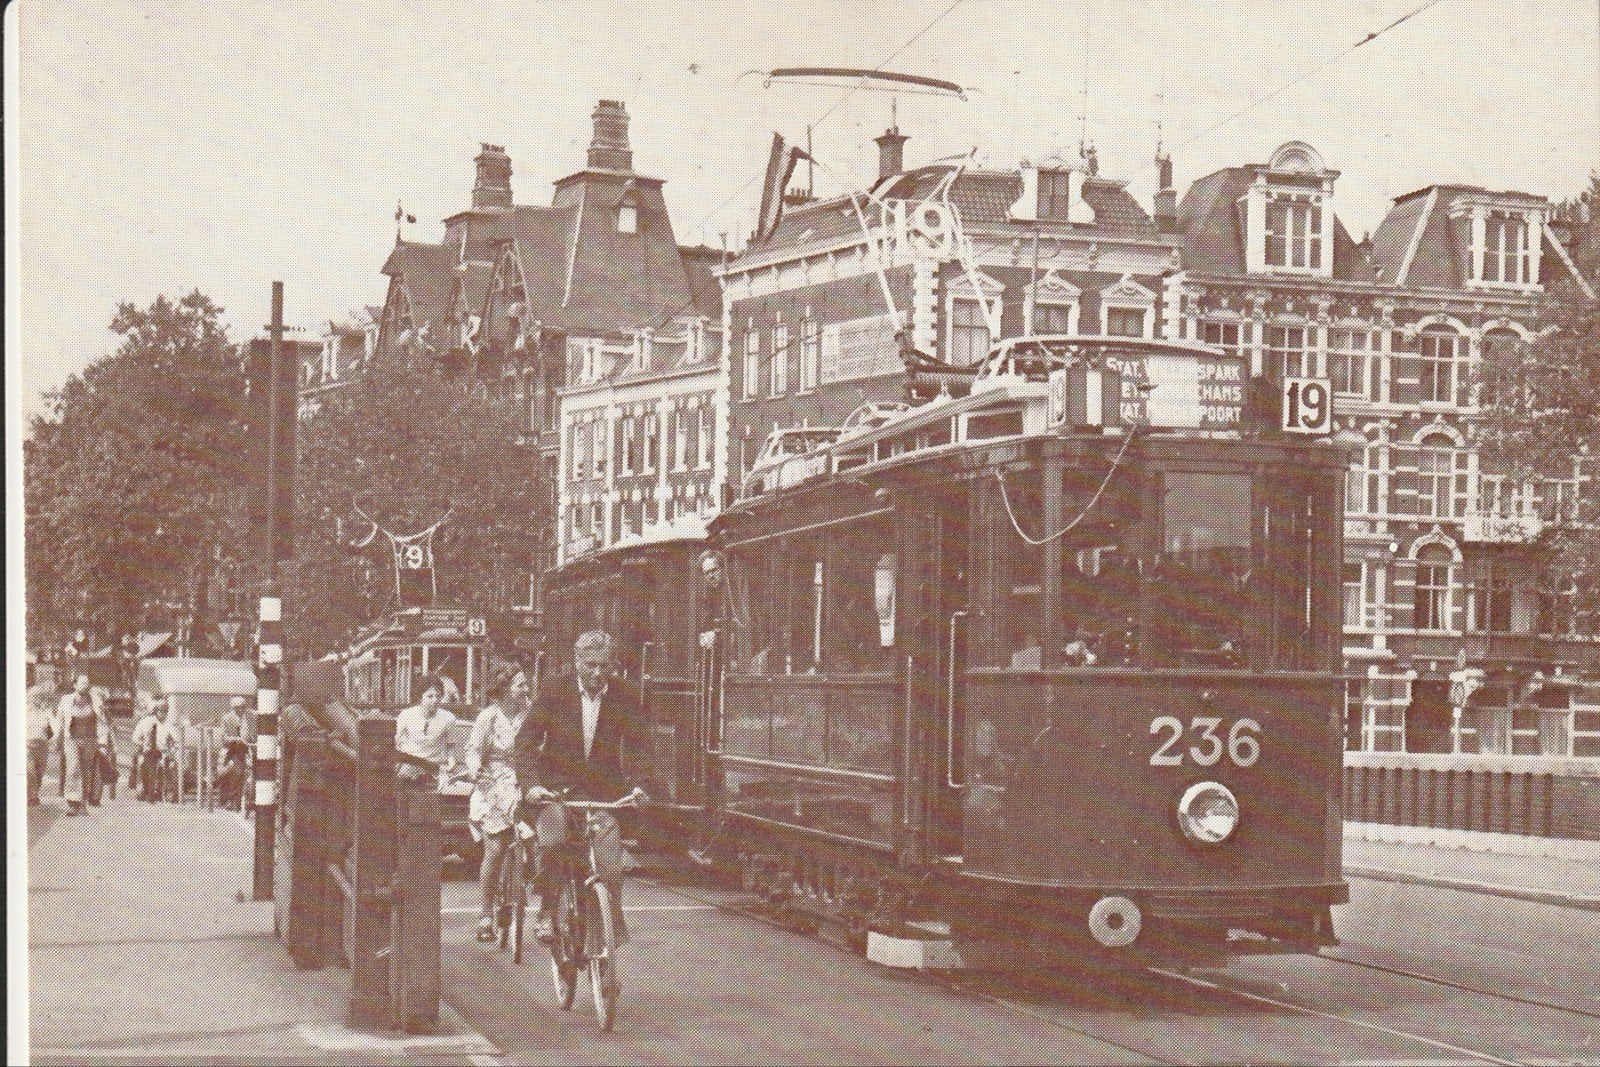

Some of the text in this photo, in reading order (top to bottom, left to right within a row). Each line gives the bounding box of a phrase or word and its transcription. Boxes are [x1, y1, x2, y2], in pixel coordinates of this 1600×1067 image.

[894, 199, 952, 258] 19
[1286, 381, 1328, 430] 19
[407, 545, 423, 569] 9
[1149, 715, 1261, 767] 236
